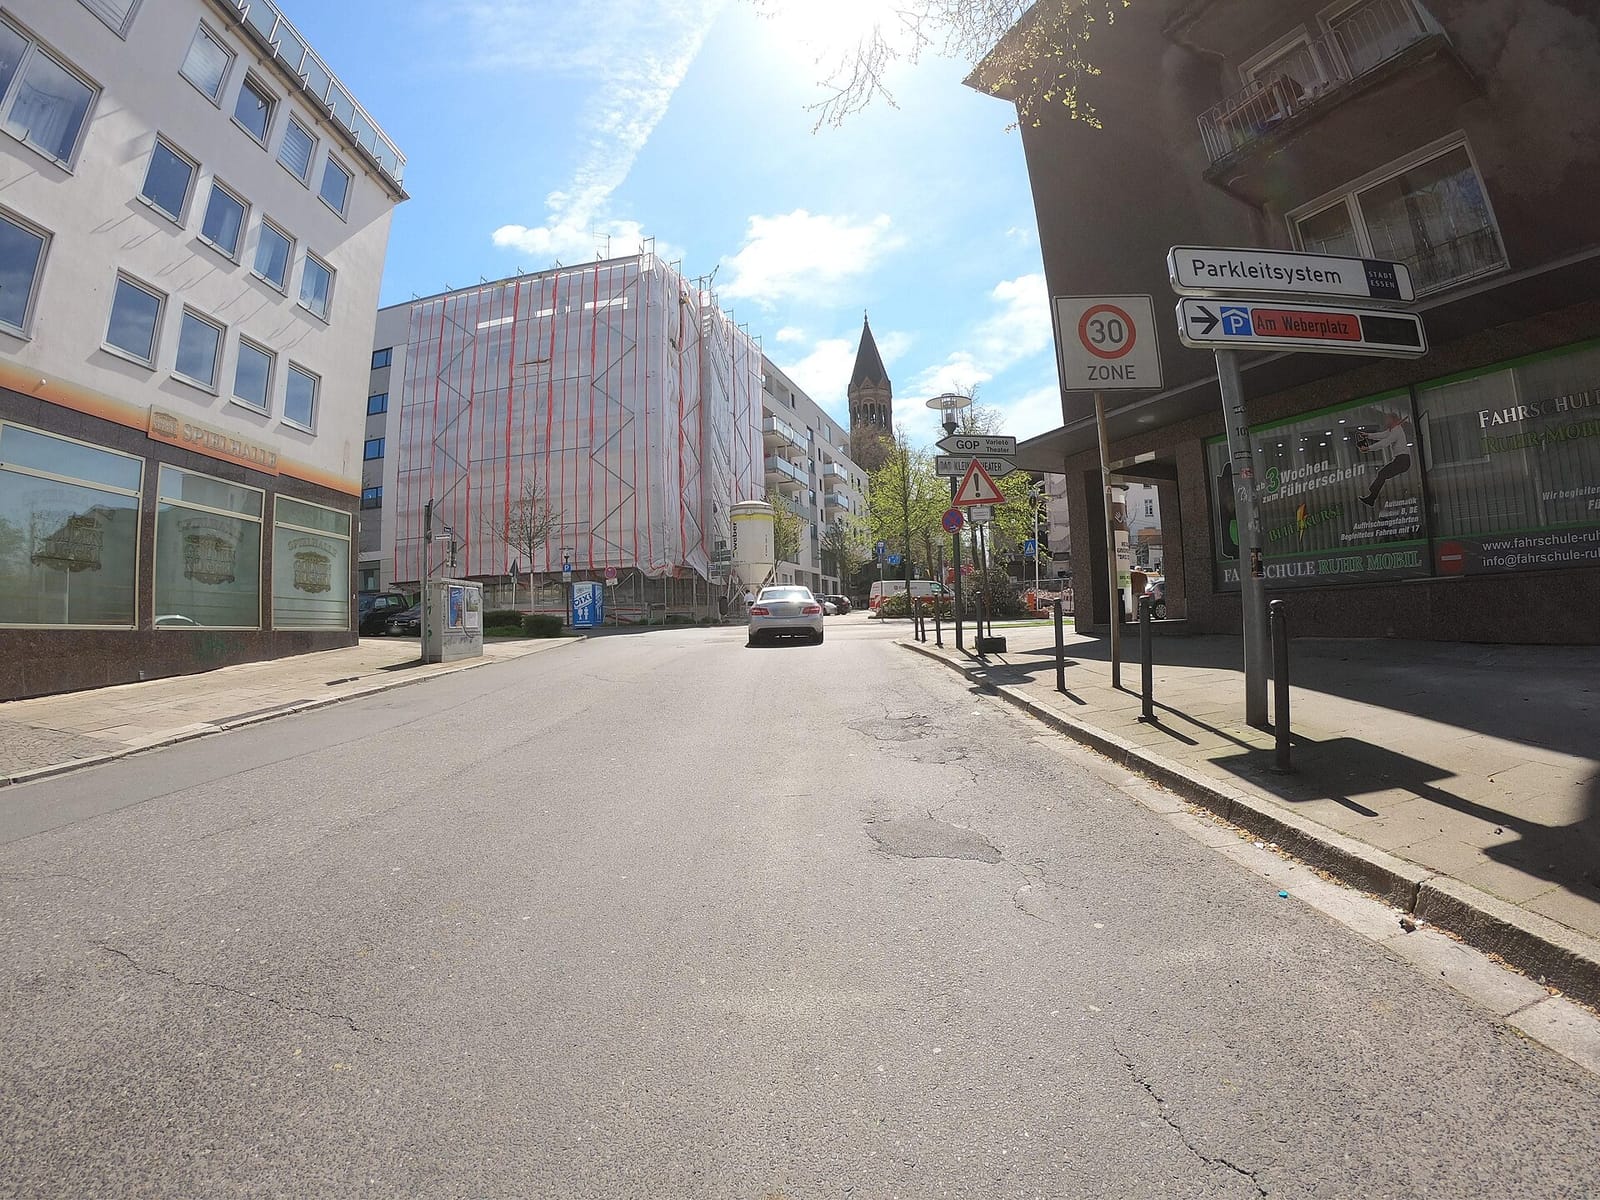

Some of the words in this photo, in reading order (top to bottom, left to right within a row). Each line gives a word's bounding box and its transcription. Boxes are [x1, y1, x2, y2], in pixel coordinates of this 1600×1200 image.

[1191, 258, 1342, 285] Parkleitsystem
[1368, 271, 1393, 280] STADT
[1370, 279, 1395, 289] ESSEN
[1090, 318, 1123, 344] 30
[1257, 314, 1277, 330] Am
[1281, 315, 1349, 336] Weberplatz
[1087, 364, 1136, 381] ZONE
[183, 423, 278, 468] SPIELHALLE
[956, 440, 980, 450] GOP
[1256, 482, 1265, 491] ab
[1265, 466, 1280, 493] 3
[1280, 460, 1329, 484] Wochen
[1262, 493, 1279, 503] zum
[1280, 463, 1366, 499] Führerschein
[1411, 524, 1420, 533] 17
[1317, 555, 1364, 575] RUHR
[1366, 550, 1422, 571] MOBIL
